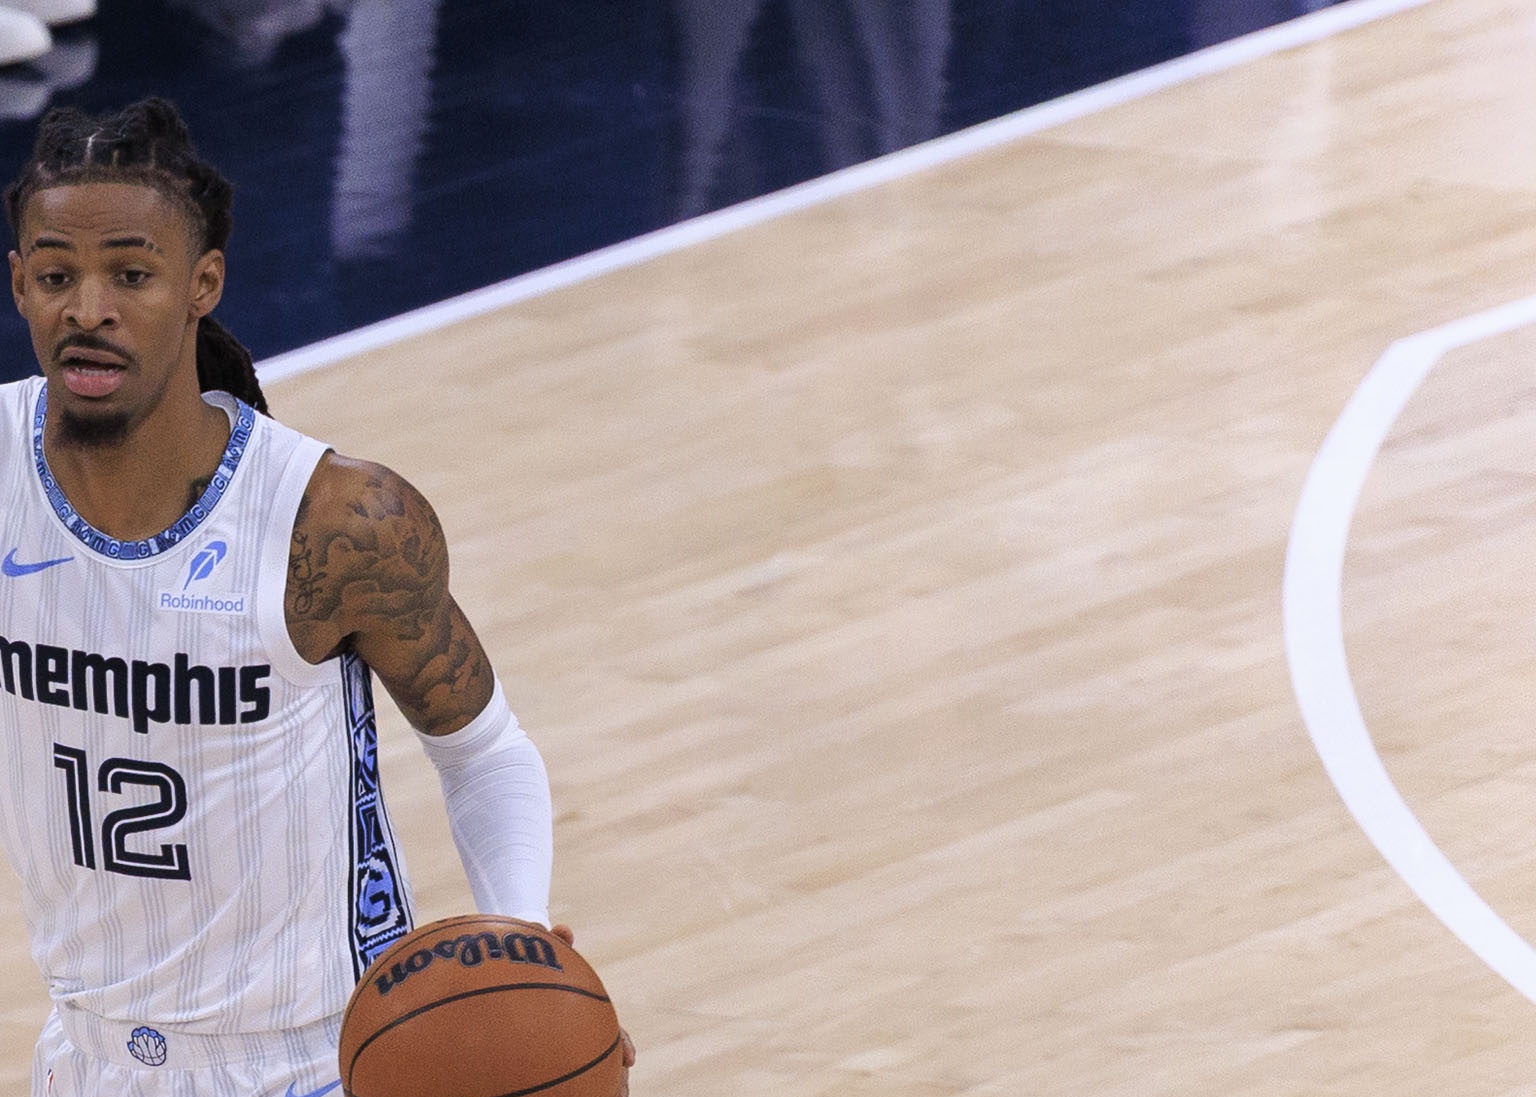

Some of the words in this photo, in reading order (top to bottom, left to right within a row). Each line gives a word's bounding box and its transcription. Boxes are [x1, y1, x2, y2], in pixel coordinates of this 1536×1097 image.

[160, 592, 244, 612] Robinhood
[53, 742, 192, 882] 12
[374, 932, 563, 996] Wilson
